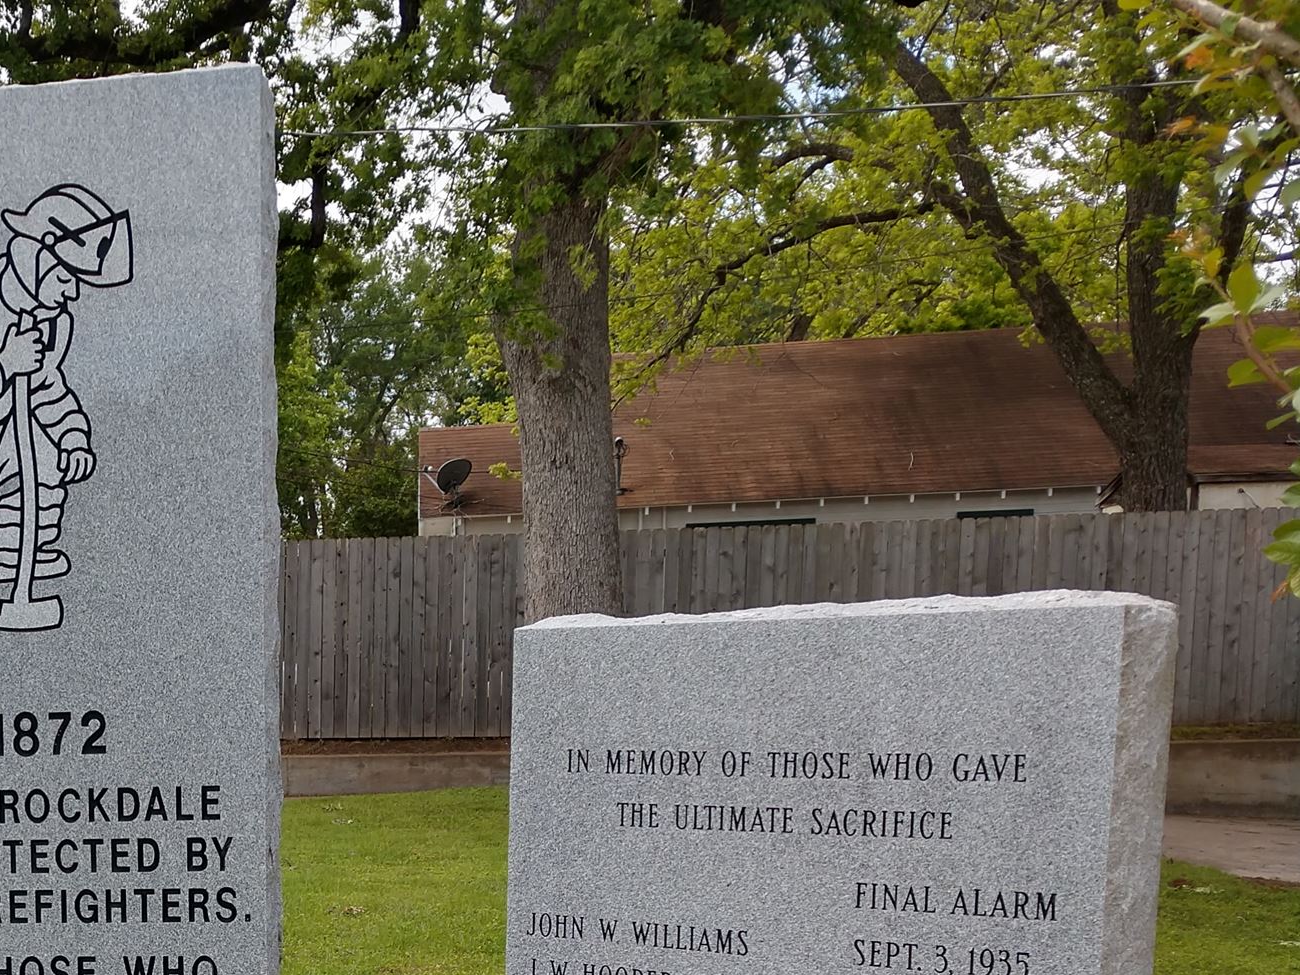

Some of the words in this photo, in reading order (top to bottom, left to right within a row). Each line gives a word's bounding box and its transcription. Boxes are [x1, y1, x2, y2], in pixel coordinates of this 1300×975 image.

[567, 748, 590, 774] IN
[605, 749, 708, 777] MEMORY
[720, 749, 752, 778] OF
[766, 751, 851, 780] THOSE
[867, 752, 934, 782] WHO
[951, 752, 1027, 783] GAVE
[616, 801, 660, 829] THE
[674, 804, 794, 834] ULTIMATE
[810, 807, 953, 840] SACRIFICE
[186, 836, 234, 872] BY
[854, 881, 937, 914] FINAL
[949, 888, 1058, 922] ALARM
[526, 912, 585, 940] JOHN
[631, 920, 749, 957] WILLIAMS
[852, 938, 922, 972] SEPT.
